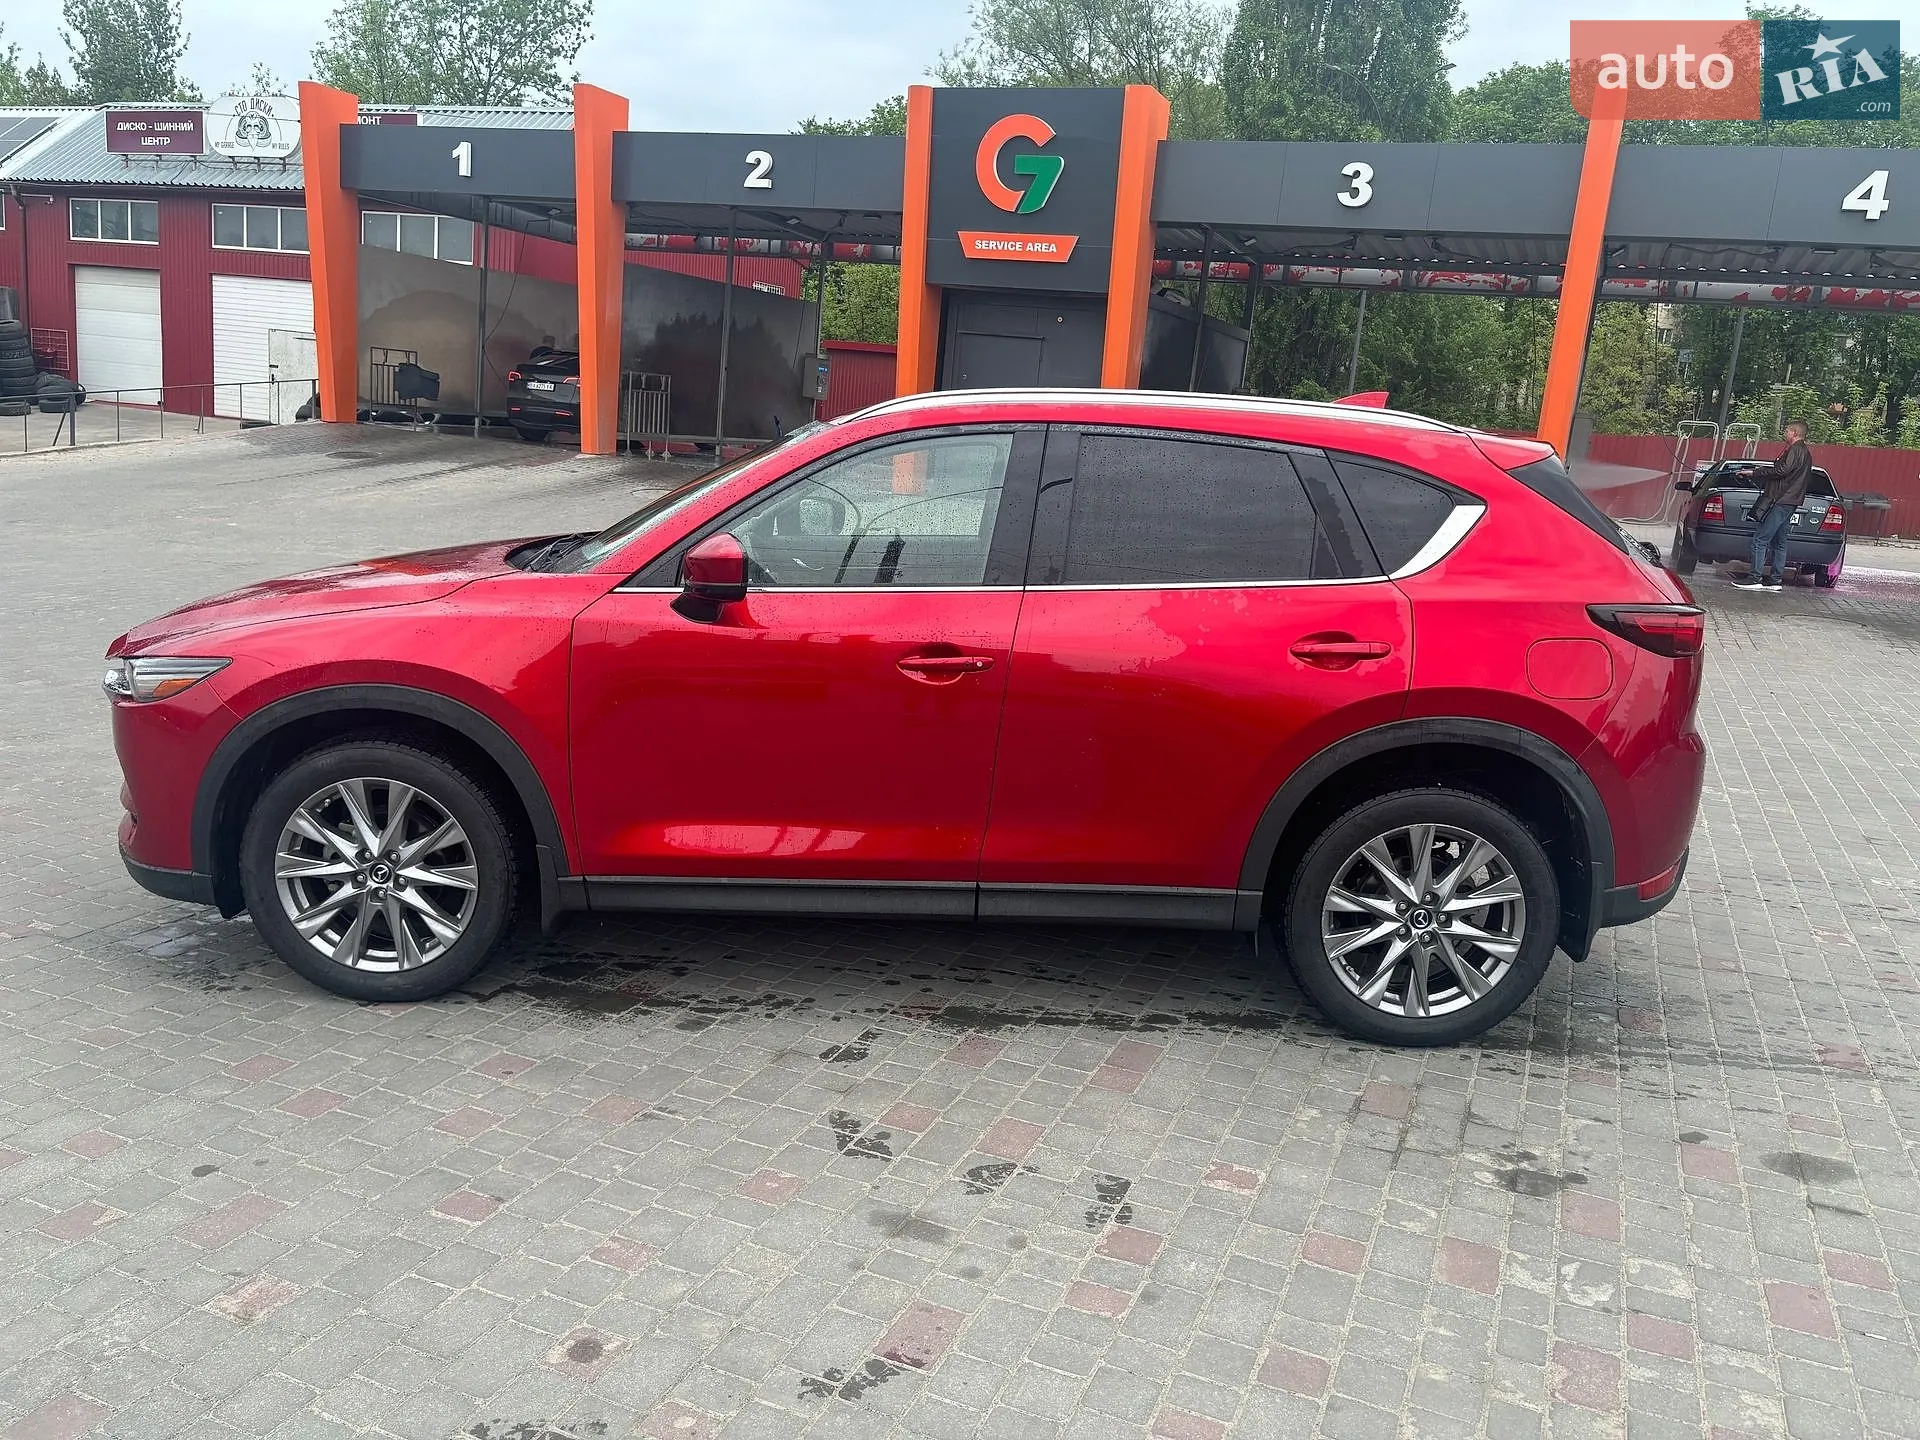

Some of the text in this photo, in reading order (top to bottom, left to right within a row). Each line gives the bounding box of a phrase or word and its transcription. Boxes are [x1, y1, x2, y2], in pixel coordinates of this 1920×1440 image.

[234, 97, 274, 117] СТО ДИСКИ
[116, 122, 147, 131] ДИСКО
[154, 120, 194, 131] ШИННИЙ
[141, 136, 171, 146] ЦЕНТР
[452, 141, 472, 177] 1
[743, 150, 773, 189] 2
[1336, 161, 1374, 207] 3
[1841, 170, 1890, 220] 4
[974, 239, 1057, 253] SERVICE AREA
